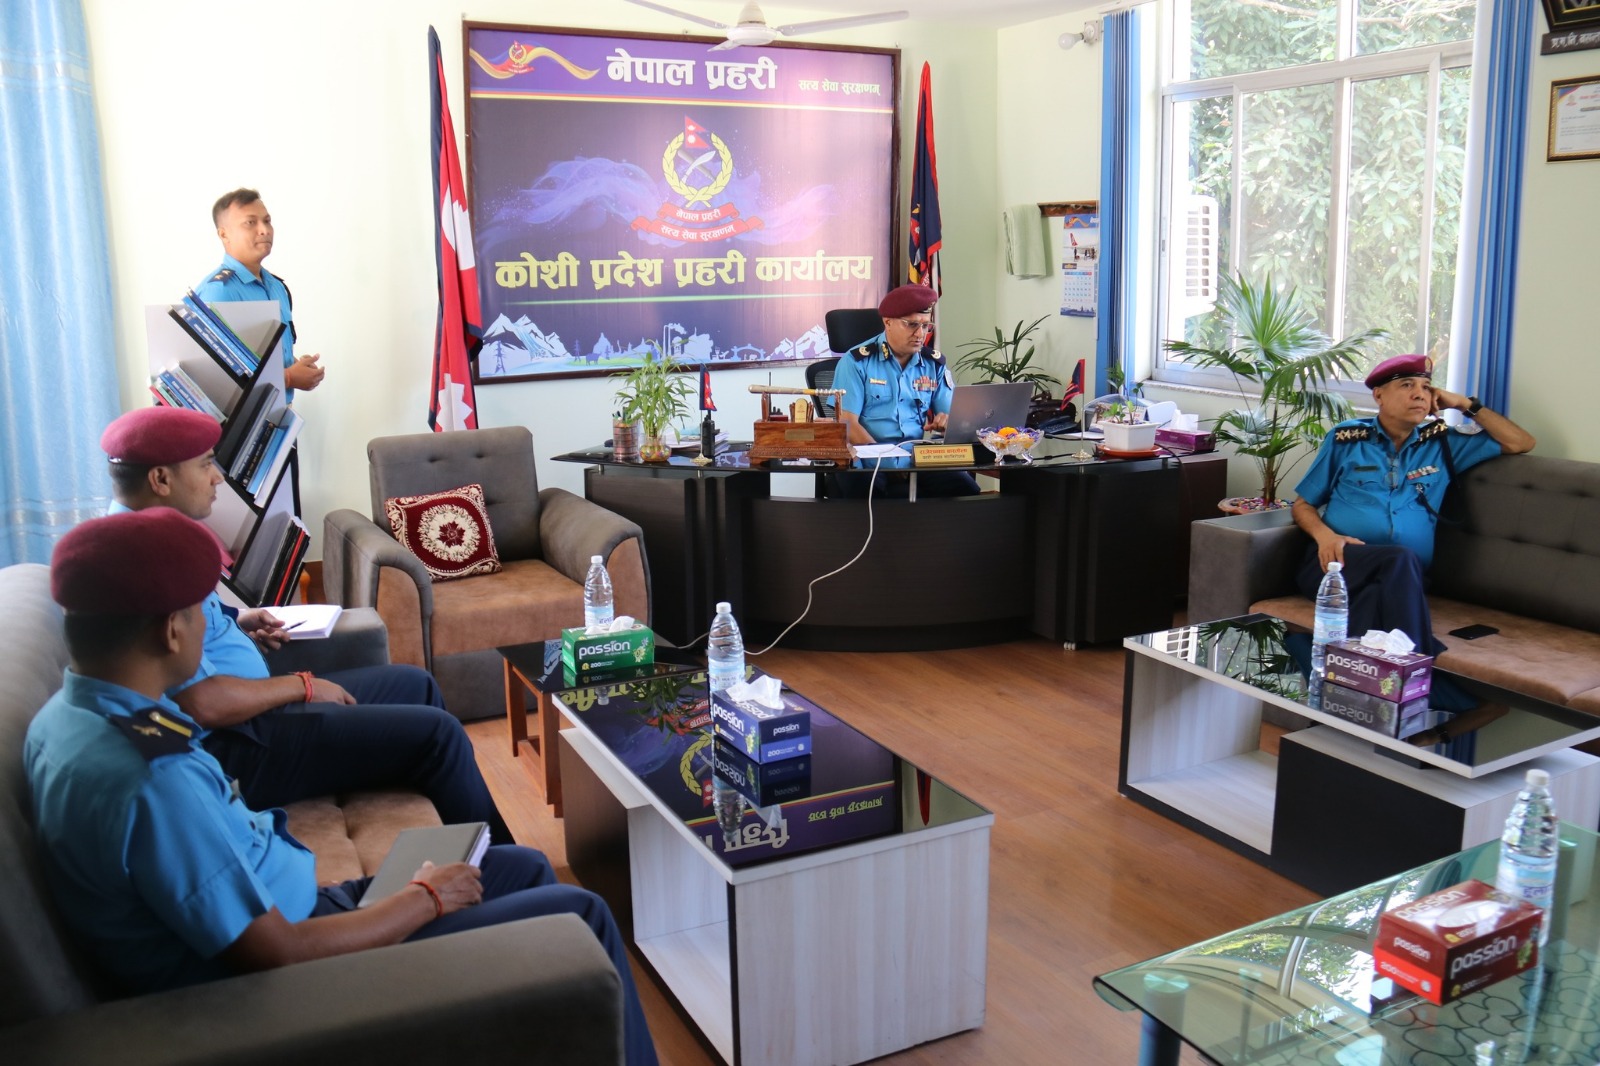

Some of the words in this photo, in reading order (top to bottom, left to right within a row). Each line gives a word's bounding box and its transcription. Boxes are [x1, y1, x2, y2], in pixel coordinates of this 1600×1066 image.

[606, 47, 696, 86] नेपाल
[705, 56, 778, 90] प्रहरी
[798, 80, 820, 91] सत्य
[822, 78, 839, 92] सेवा
[841, 82, 881, 96] सुरक्षणम्
[676, 209, 699, 221] नेपाल
[701, 204, 721, 221] प्रहरी
[660, 225, 680, 238] सत्य
[682, 229, 697, 240] सेवा
[700, 224, 736, 241] सुरक्षणम्
[495, 252, 580, 290] कोशी
[590, 251, 664, 290] प्रदेश
[673, 249, 747, 288] प्रहरी
[755, 249, 874, 282] कार्यालय
[579, 640, 631, 660] passion
[1326, 653, 1379, 677] passion
[713, 703, 744, 732] passion
[773, 723, 800, 736] passion
[1394, 937, 1431, 960] passion
[1451, 935, 1517, 979] passion
[1380, 962, 1397, 975] 200
